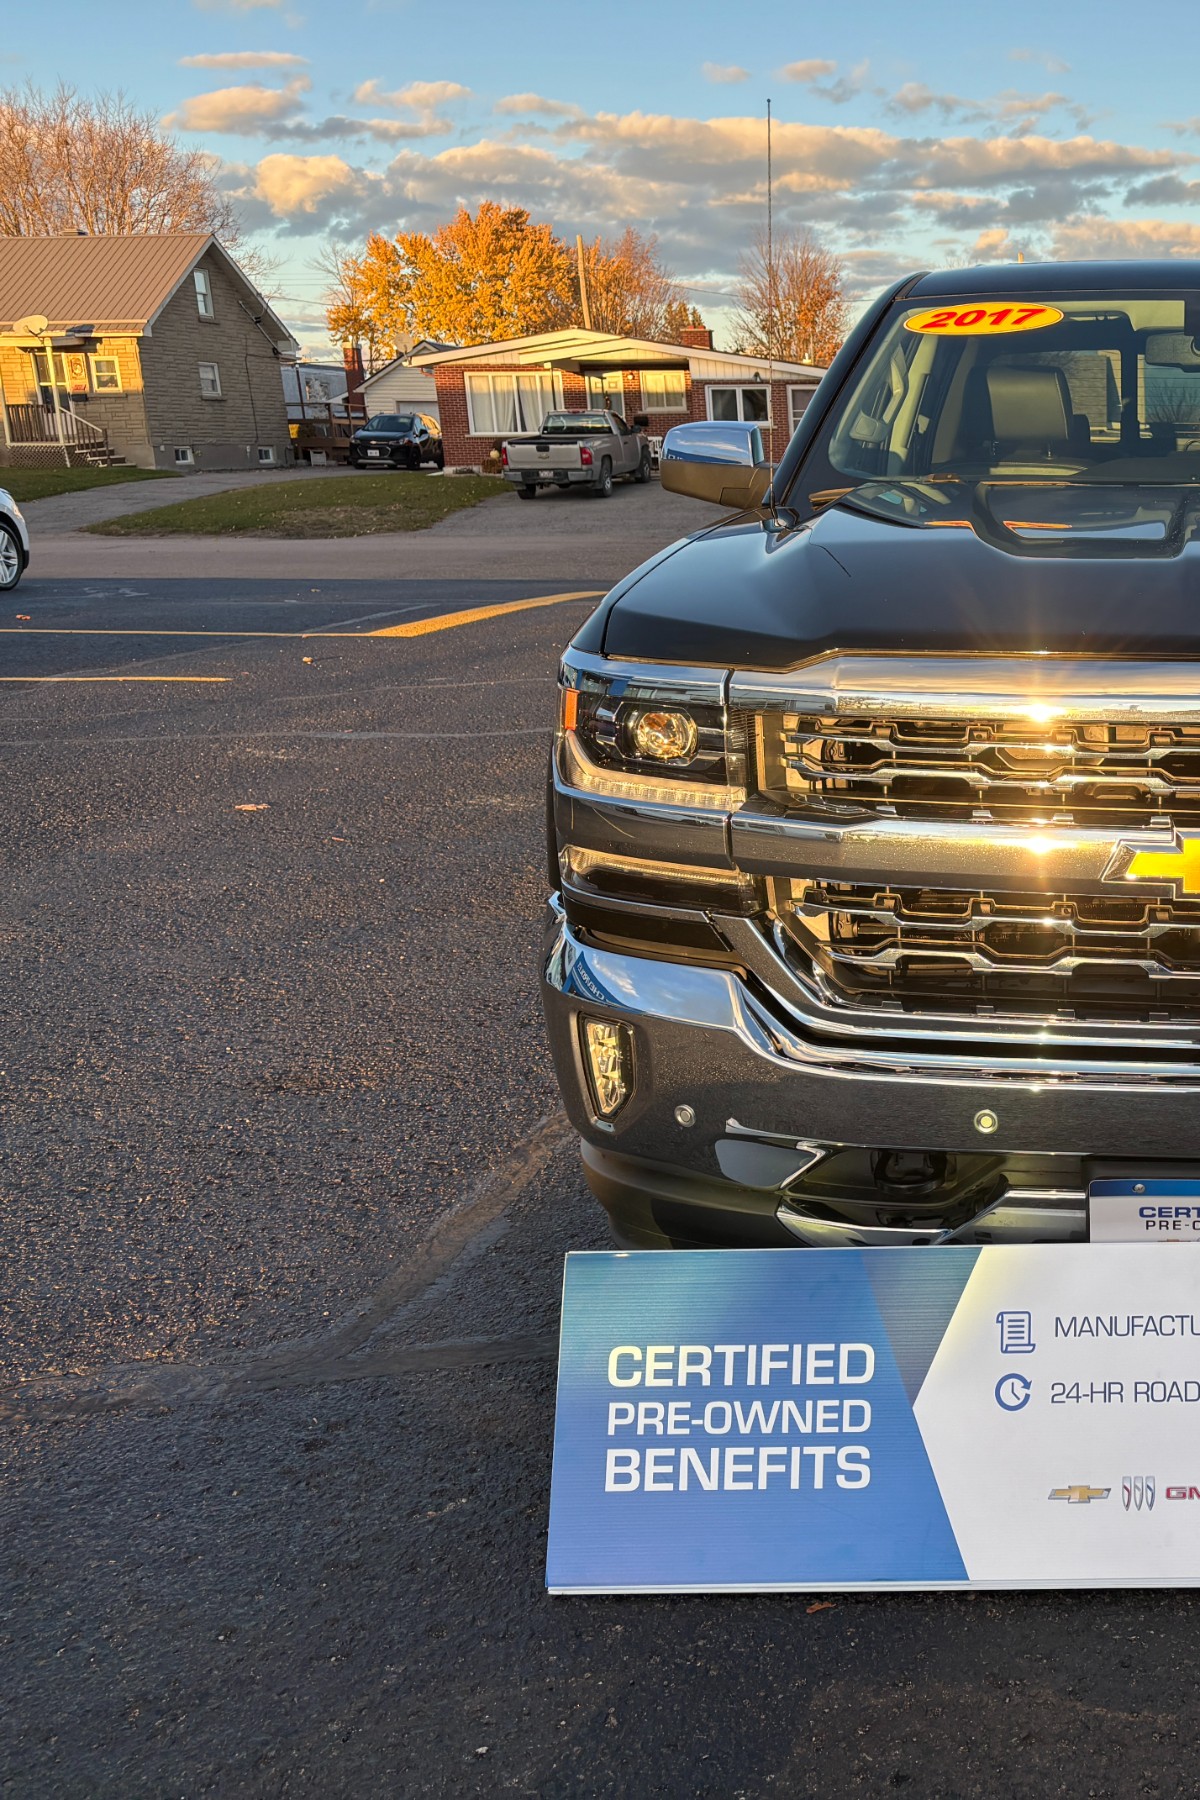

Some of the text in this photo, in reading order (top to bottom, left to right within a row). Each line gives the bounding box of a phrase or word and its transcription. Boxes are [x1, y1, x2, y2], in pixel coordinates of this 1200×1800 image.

[919, 308, 1047, 328] 2017
[607, 1343, 875, 1388] CERTIFIED
[1050, 1382, 1124, 1404] 24-HR
[607, 1399, 872, 1435] PRE-OWNED
[604, 1445, 870, 1492] BENEFITS
